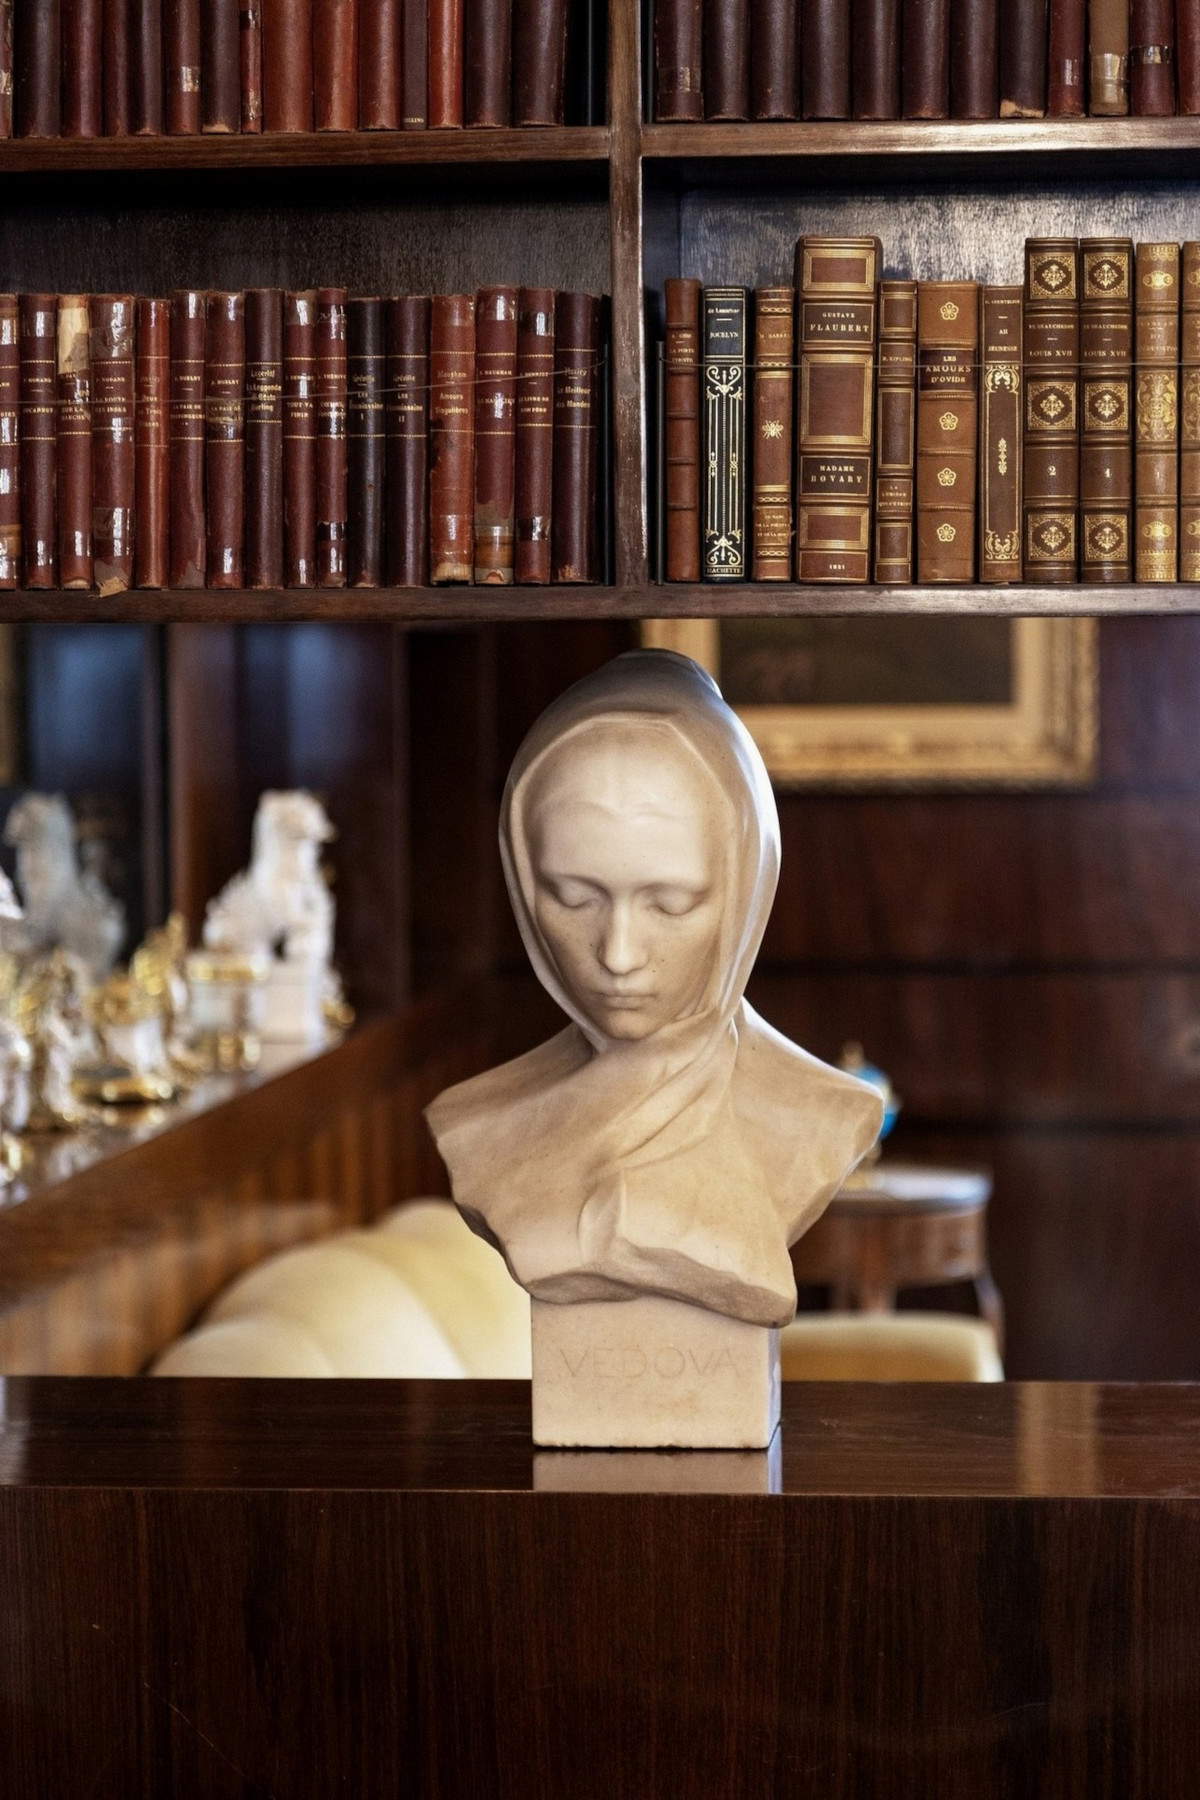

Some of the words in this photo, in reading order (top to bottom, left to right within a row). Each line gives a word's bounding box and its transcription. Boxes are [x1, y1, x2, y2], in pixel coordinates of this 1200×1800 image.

[810, 324, 869, 332] FLAUBERT
[710, 331, 738, 339] JOCELYN
[1048, 466, 1056, 476] 2
[811, 475, 862, 483] BOVARY
[560, 1347, 740, 1379] VEDOVA
